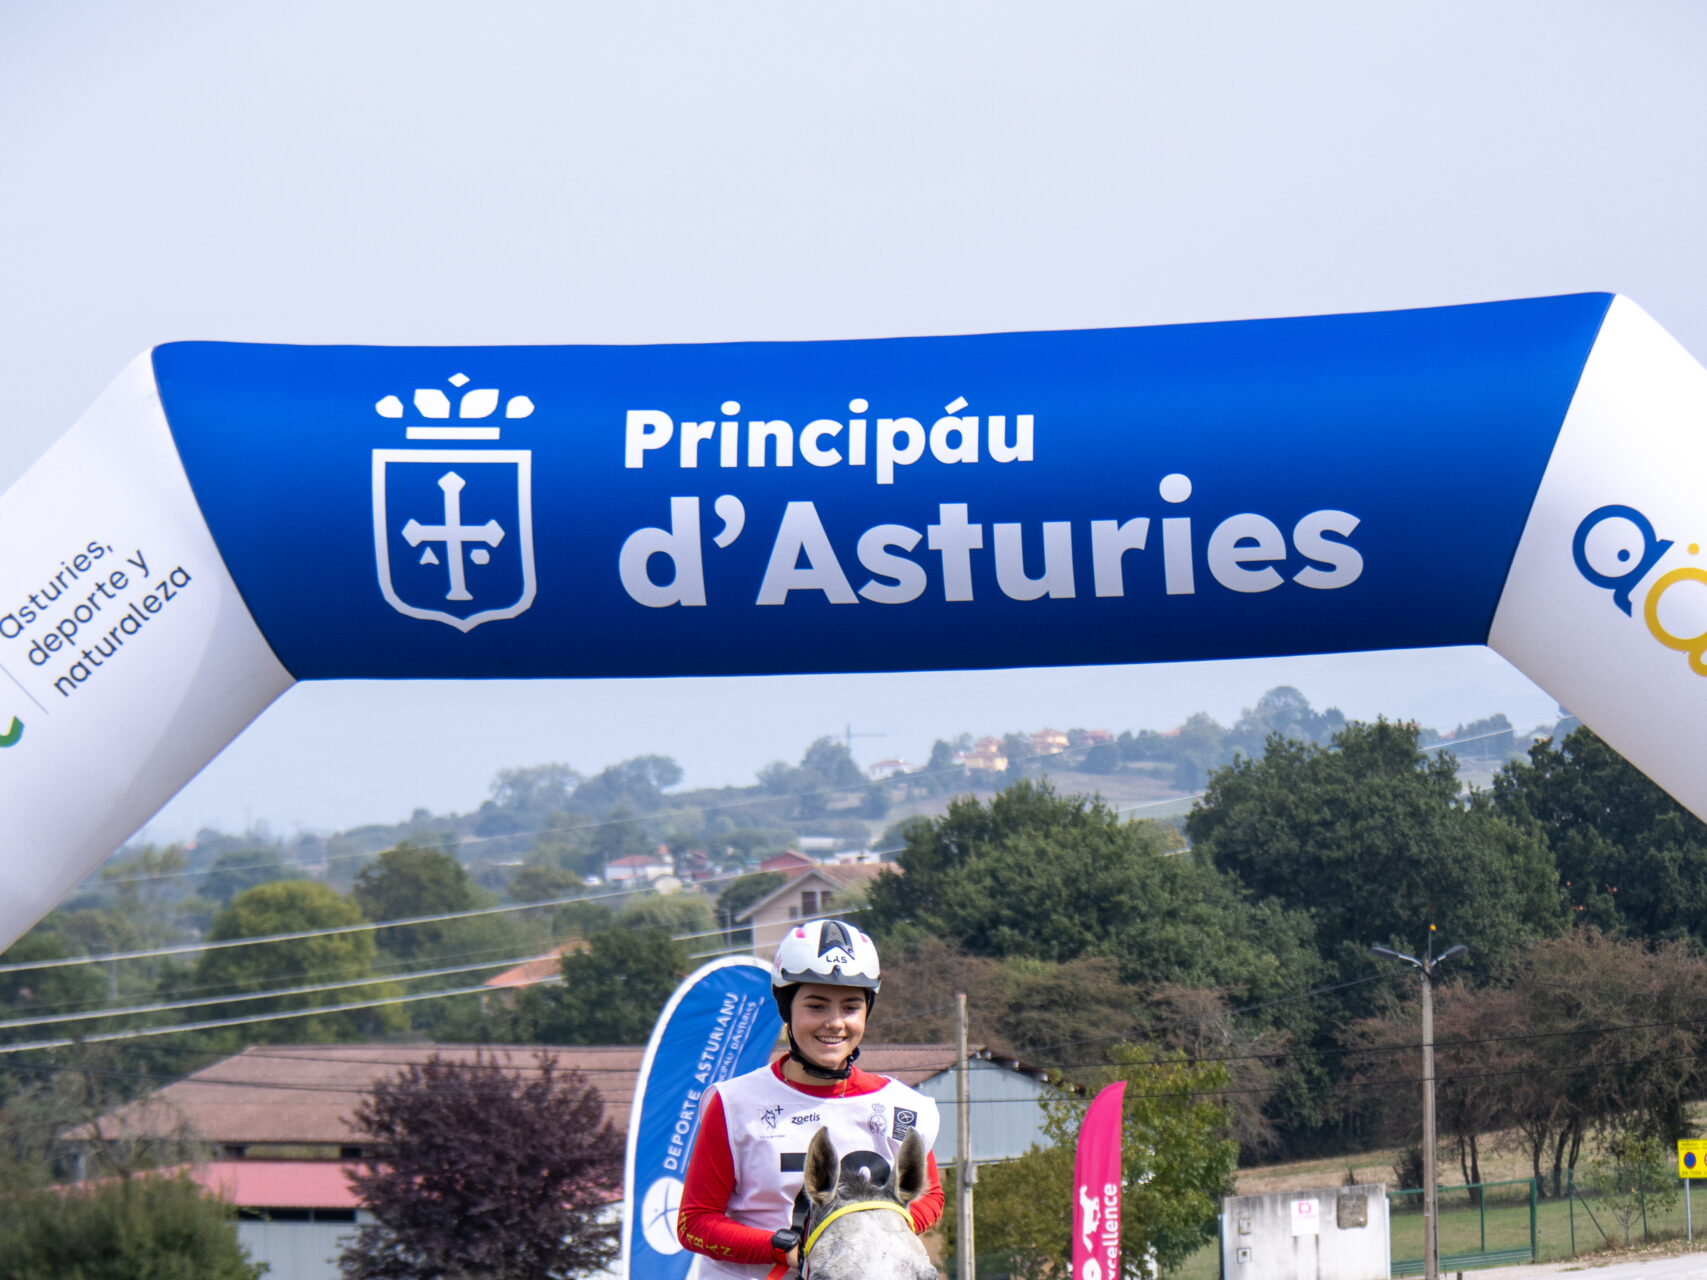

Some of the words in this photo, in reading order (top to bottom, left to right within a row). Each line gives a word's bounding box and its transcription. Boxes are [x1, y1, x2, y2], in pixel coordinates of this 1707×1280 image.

[624, 394, 1035, 485] Principáu
[0, 541, 113, 639] asturies,
[618, 473, 1364, 607] d’Asturies
[28, 570, 129, 666] deporte
[126, 549, 149, 578] y
[54, 566, 192, 697] naturaleza
[826, 955, 848, 964] LAS
[663, 1089, 701, 1171] DEPORTE
[694, 992, 739, 1085] ASTURIANU
[791, 1112, 821, 1125] zoetis
